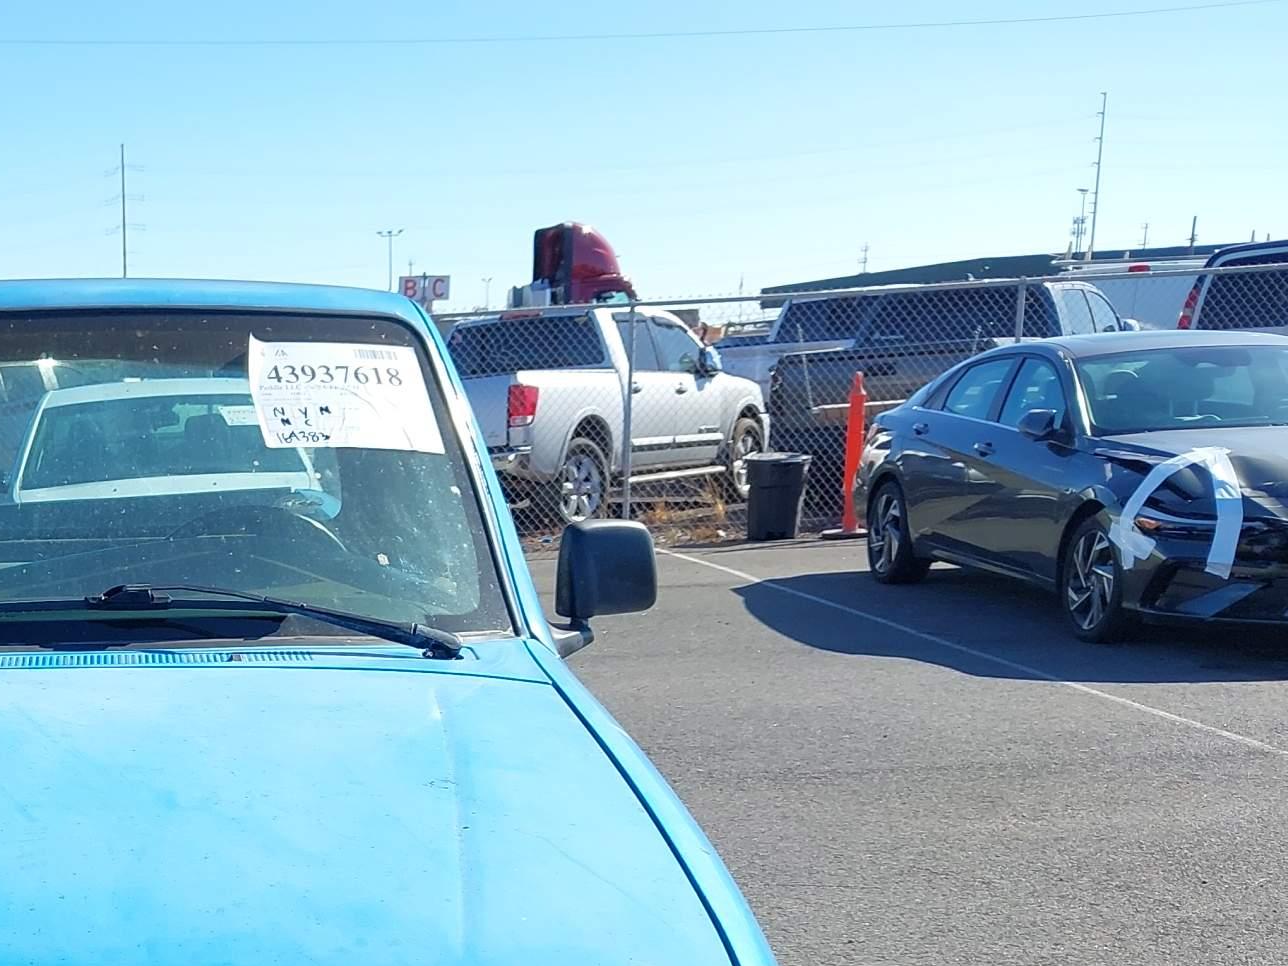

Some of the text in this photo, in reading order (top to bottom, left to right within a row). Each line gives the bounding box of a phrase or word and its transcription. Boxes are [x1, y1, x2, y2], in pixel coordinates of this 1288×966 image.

[404, 278, 445, 298] B C
[266, 364, 403, 387] 43937618
